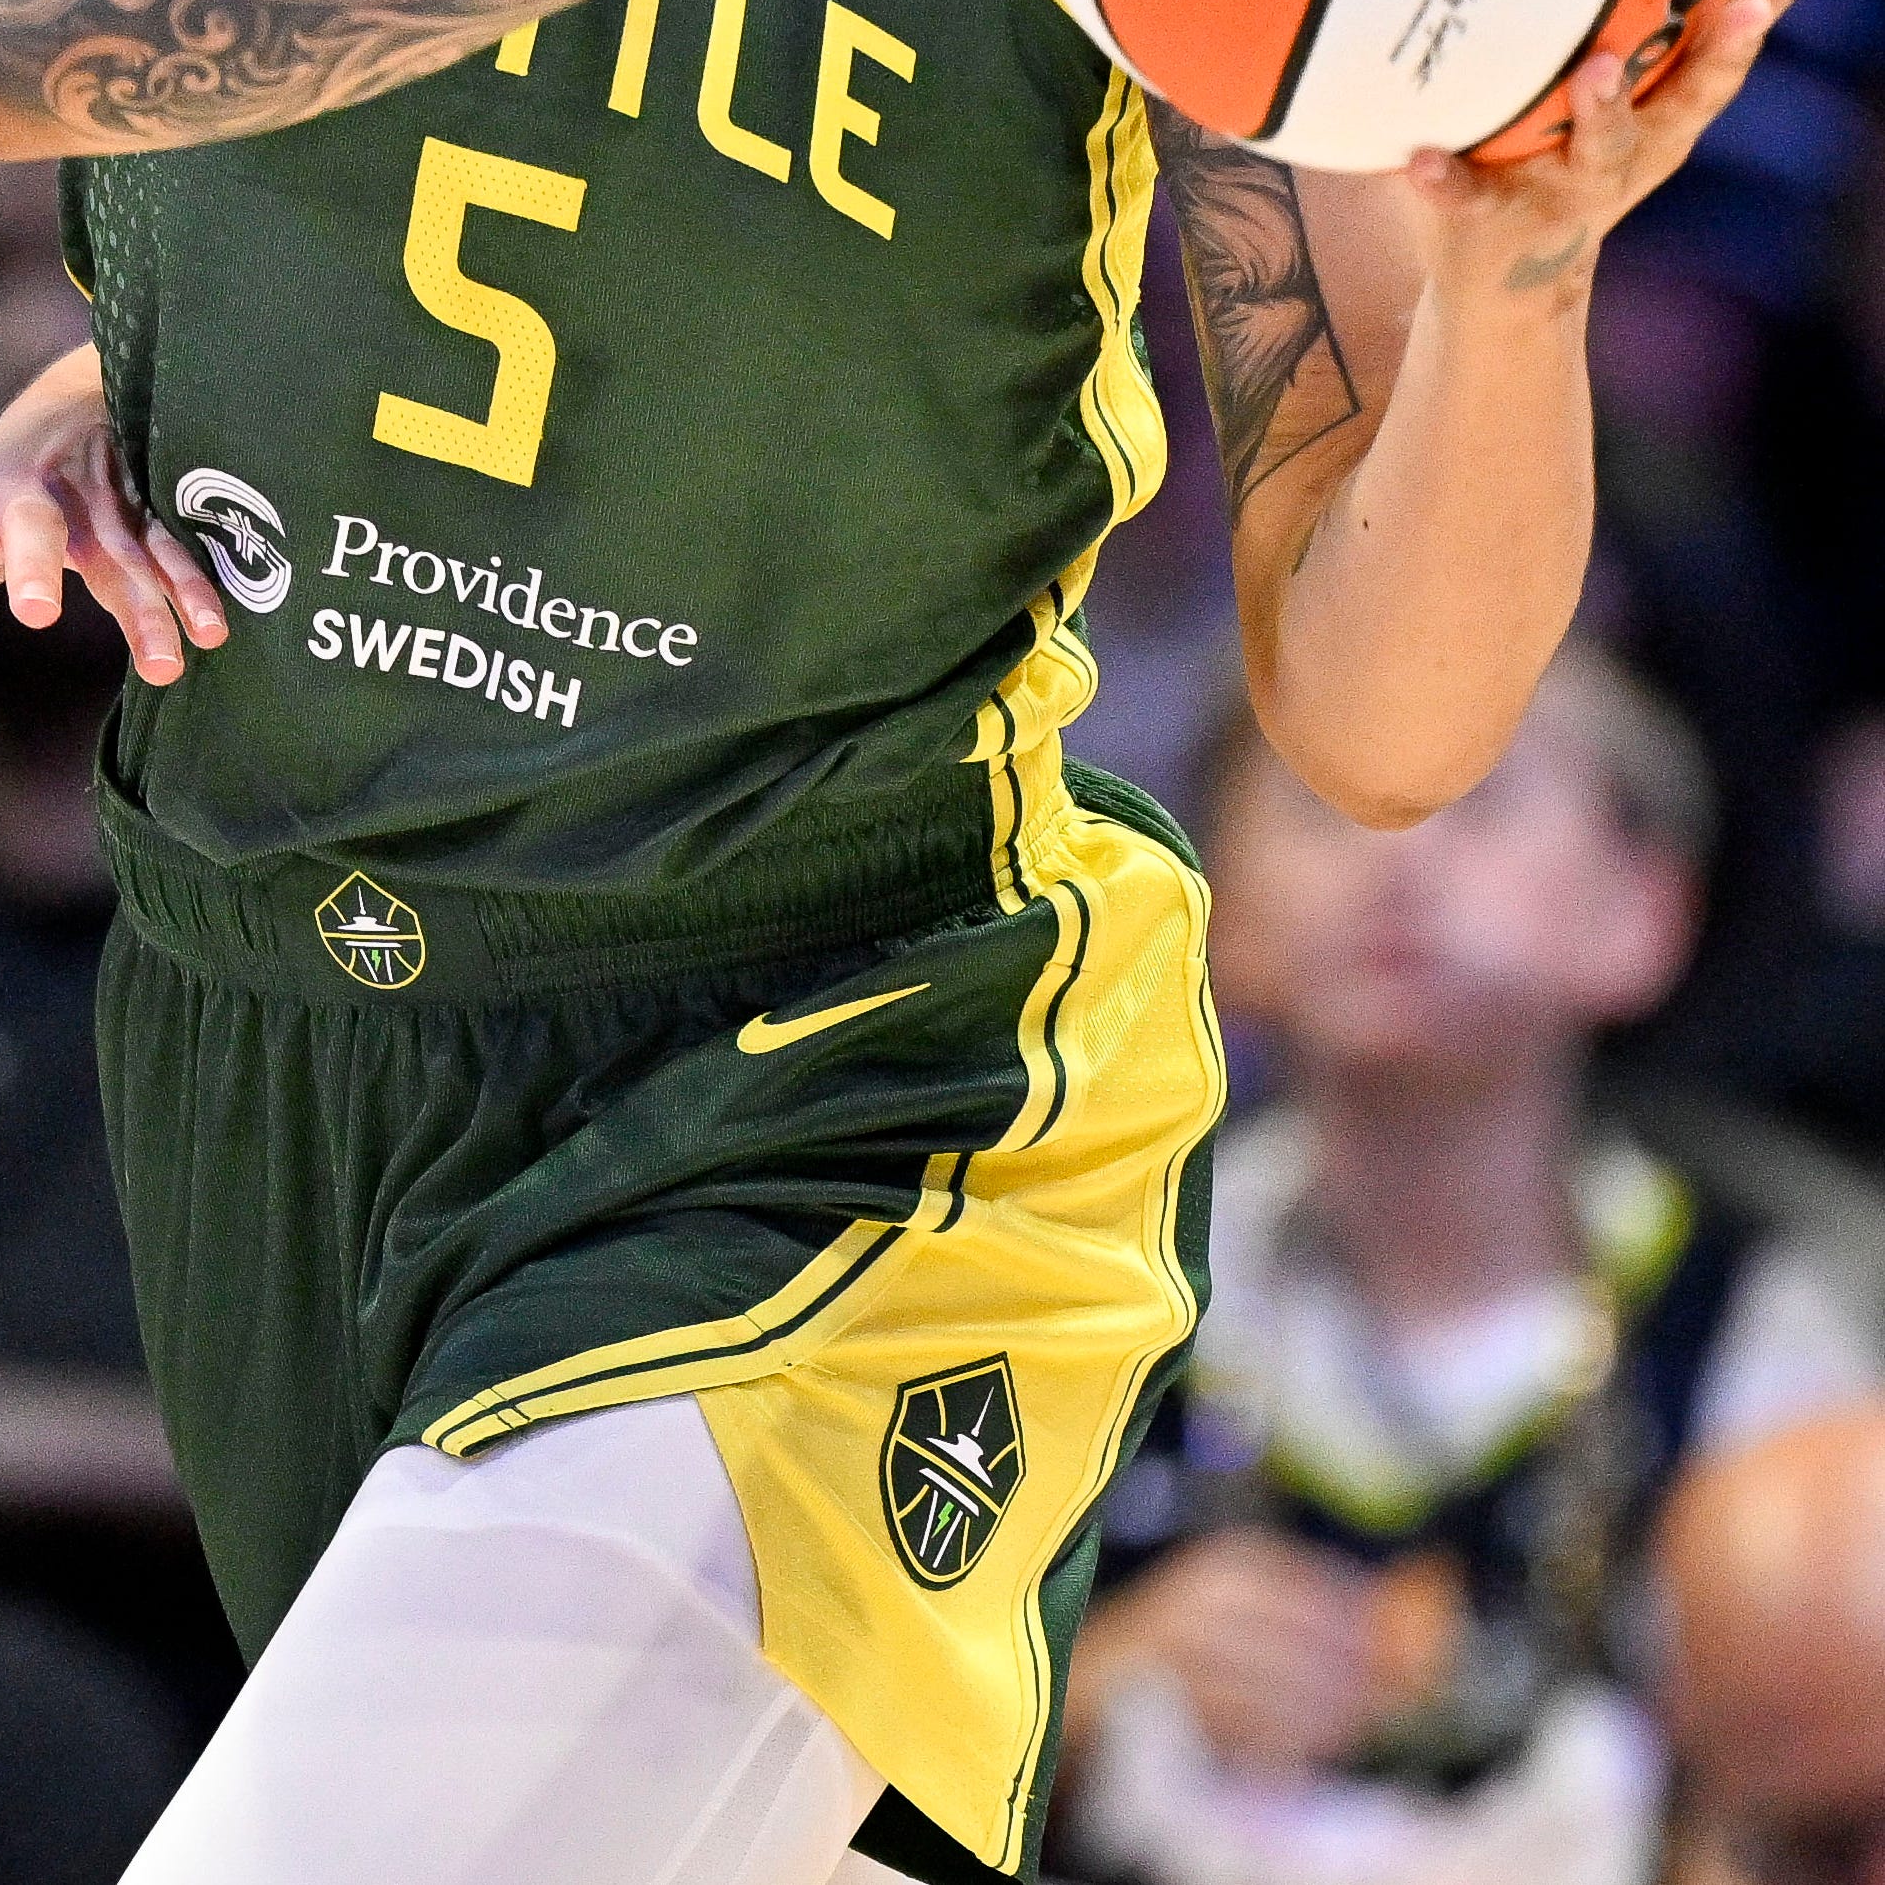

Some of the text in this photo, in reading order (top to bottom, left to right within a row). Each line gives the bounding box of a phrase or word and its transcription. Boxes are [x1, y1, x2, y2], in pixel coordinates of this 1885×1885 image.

[372, 135, 588, 489] 5
[321, 514, 700, 667] Providence
[307, 608, 583, 729] SWEDISH
